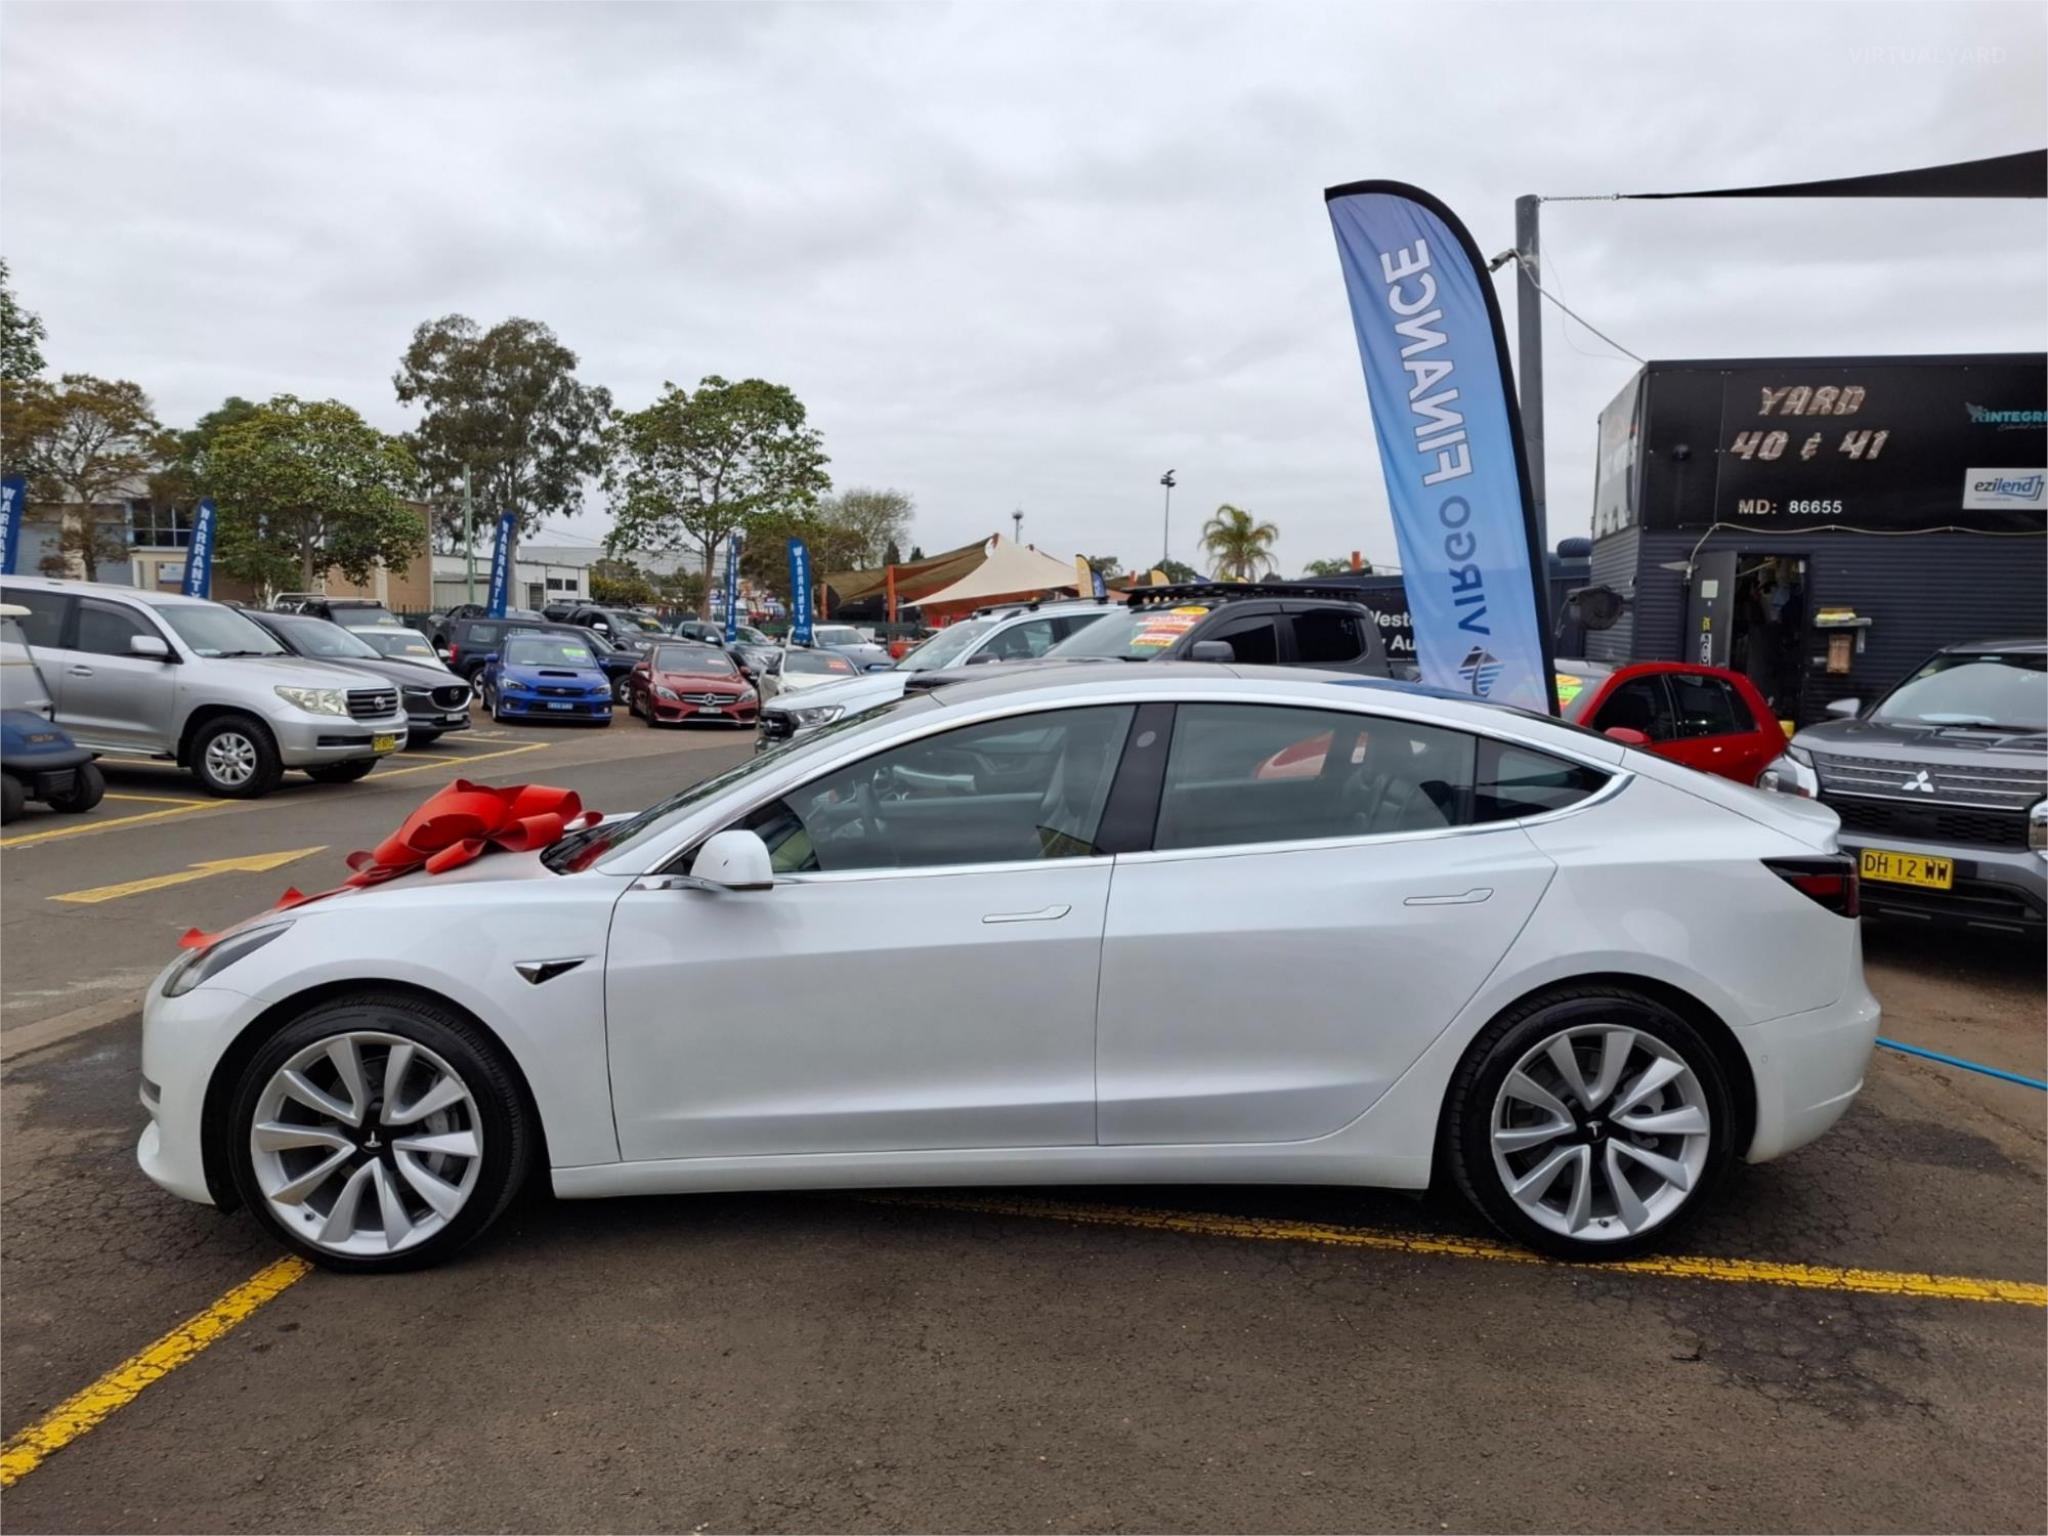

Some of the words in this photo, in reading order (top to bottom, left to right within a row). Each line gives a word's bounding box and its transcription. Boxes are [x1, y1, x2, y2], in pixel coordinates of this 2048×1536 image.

[1758, 386, 1866, 416] YARD
[1729, 430, 1790, 460] 40
[1801, 432, 1822, 460] &
[1839, 430, 1890, 460] 41
[1974, 478, 2035, 492] ezilend
[1738, 500, 1777, 514] MD:
[1789, 501, 1842, 514] 86655
[1864, 854, 1888, 874] DH
[1897, 858, 1917, 878] 12
[1925, 861, 1949, 881] WW
